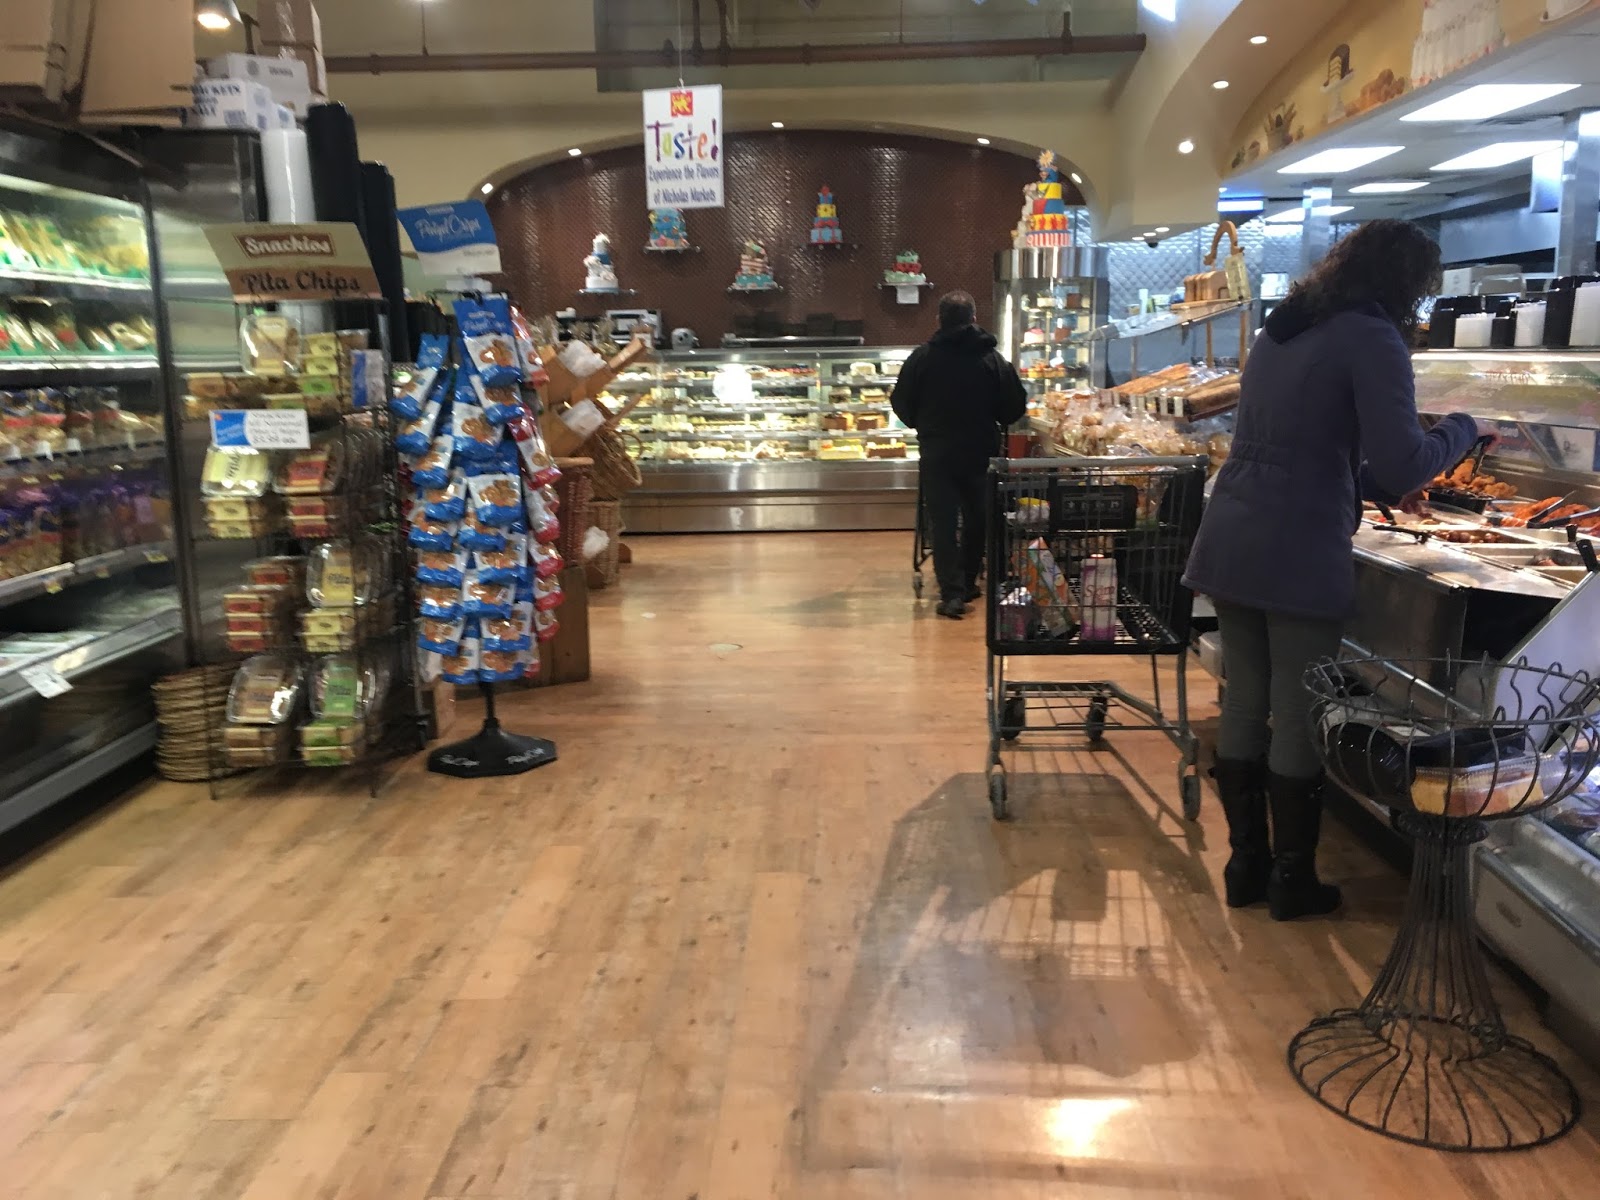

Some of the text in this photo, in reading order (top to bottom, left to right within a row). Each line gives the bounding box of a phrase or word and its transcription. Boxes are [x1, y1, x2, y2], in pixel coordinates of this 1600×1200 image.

[646, 118, 719, 162] Taste!
[648, 162, 720, 183] Experience the Flavors
[653, 186, 716, 204] of Nicholas Markets
[241, 270, 360, 296] Pita Chips
